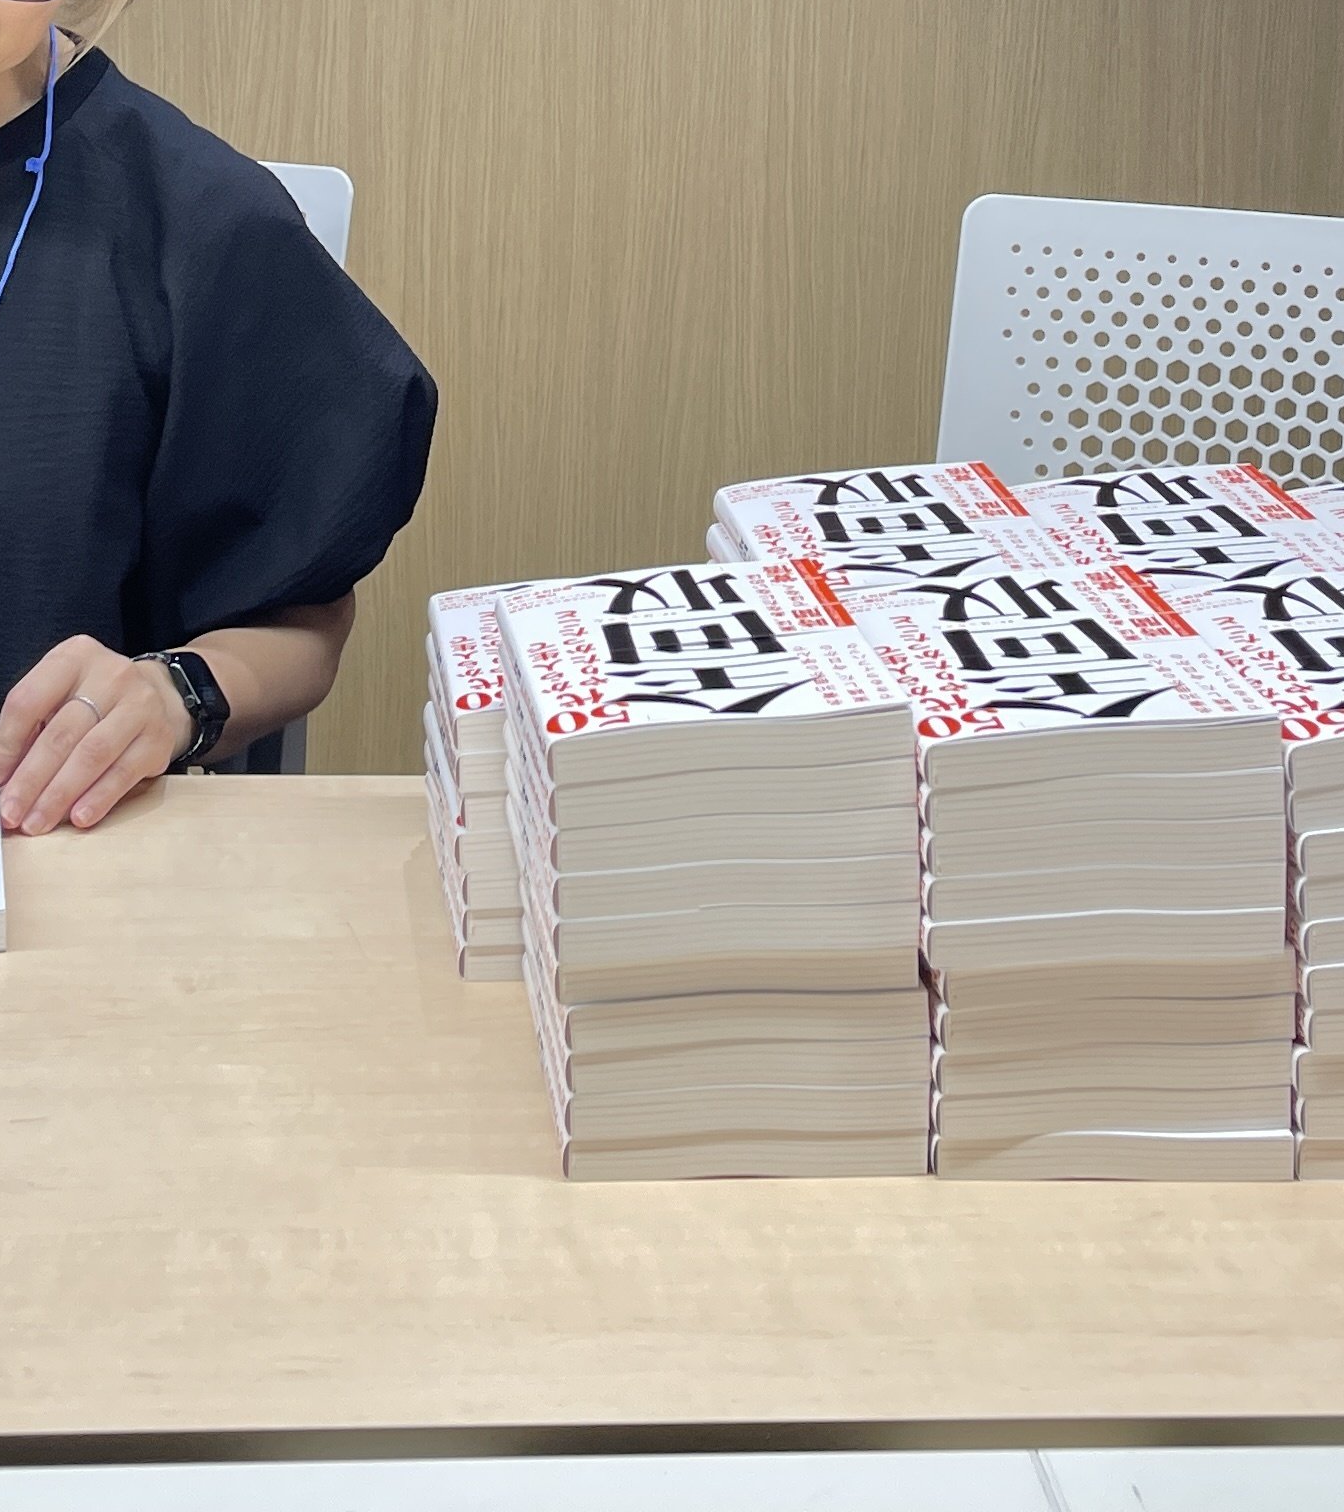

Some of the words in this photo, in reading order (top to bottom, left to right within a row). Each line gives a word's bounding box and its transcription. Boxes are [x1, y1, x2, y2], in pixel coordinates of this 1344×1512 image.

[778, 471, 1003, 577] 全回収
[1056, 472, 1306, 581] 全回収
[572, 570, 822, 713] 全回収
[898, 576, 1179, 717] 全回収
